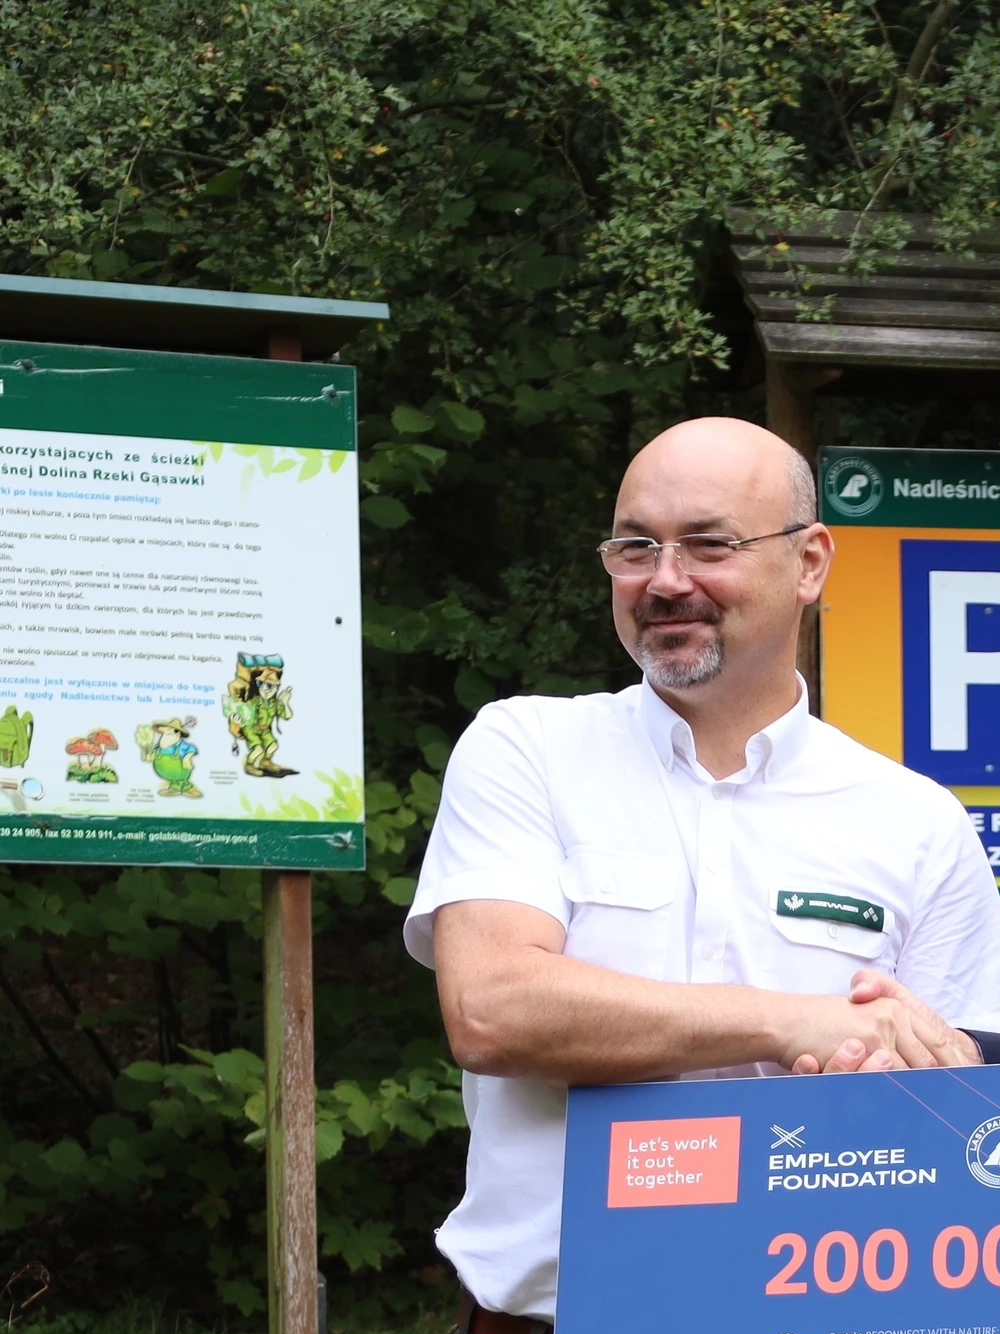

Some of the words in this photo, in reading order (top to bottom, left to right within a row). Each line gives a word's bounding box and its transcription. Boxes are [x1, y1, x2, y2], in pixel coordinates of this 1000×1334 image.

[124, 453, 140, 462] ze
[151, 452, 205, 466] ścieżki
[1, 463, 33, 479] śnej
[39, 466, 87, 479] Dolina
[93, 469, 134, 482] Rzeki
[140, 471, 205, 486] Gąsawki
[29, 487, 53, 496] lesie
[56, 489, 110, 499] koniecznie
[6, 507, 30, 517] niskiej
[32, 508, 64, 518] kulturze,
[92, 511, 107, 520] tym
[212, 517, 233, 527] długo
[0, 529, 27, 539] Dlatego
[44, 532, 67, 540] wolno
[25, 566, 48, 575] roślin,
[69, 568, 93, 576] nawet
[19, 588, 43, 596] wolno
[163, 584, 177, 593] pod
[66, 602, 90, 611] dzikim
[157, 607, 184, 616] których
[200, 609, 214, 618] jest
[48, 626, 82, 635] mrowisk,
[85, 626, 115, 635] bowiem
[17, 647, 40, 655] wolno
[44, 676, 64, 686] jest
[67, 678, 118, 687] wyłącznie
[134, 680, 173, 690] miejscu
[193, 682, 215, 692] tego
[24, 691, 54, 700] zgody
[61, 691, 130, 702] Nadleśnictwa
[137, 694, 152, 703] lub
[159, 695, 215, 707] Leśniczego
[0, 828, 10, 837] 30
[12, 828, 23, 837] 24
[45, 829, 59, 838] fax
[73, 829, 84, 838] 30
[85, 829, 97, 839] 24
[628, 1137, 669, 1153] Let's
[675, 1135, 718, 1150] work
[969, 1129, 986, 1152] LASY
[627, 1155, 640, 1169] it
[645, 1155, 674, 1169] out
[769, 1148, 905, 1171] EMPLOYEE
[626, 1170, 703, 1189] together
[768, 1168, 937, 1191] FOUNDATION
[765, 1228, 909, 1295] 200
